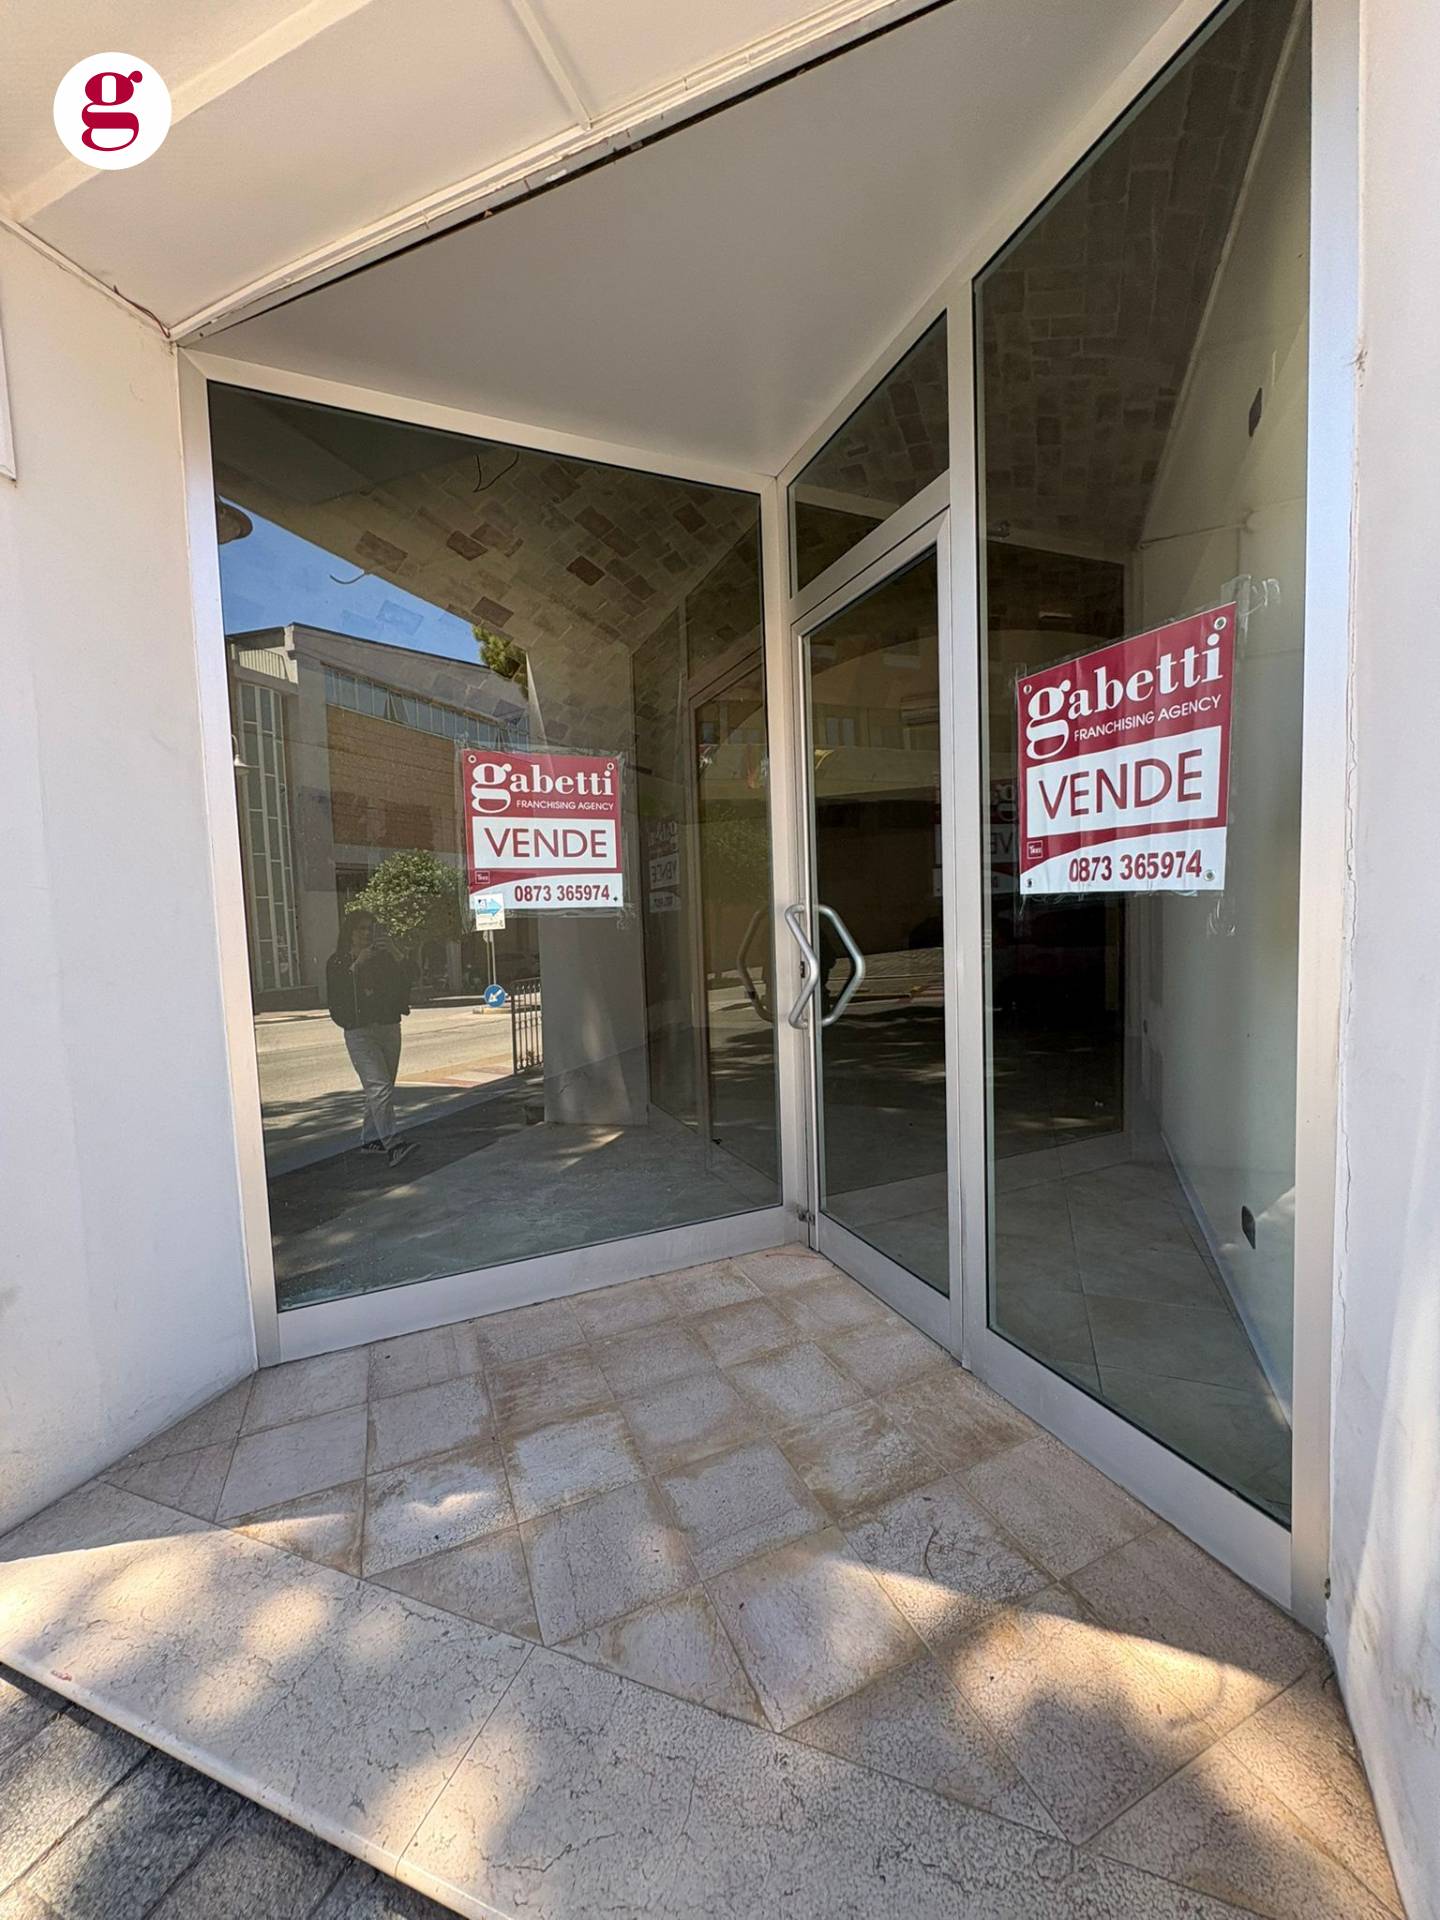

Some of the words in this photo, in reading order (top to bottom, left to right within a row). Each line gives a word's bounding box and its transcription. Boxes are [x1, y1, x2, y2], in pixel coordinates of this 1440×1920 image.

[1026, 633, 1223, 760] gabetti
[1073, 711, 1155, 742] FRANCHISING
[1157, 694, 1222, 721] AGENCY
[471, 763, 614, 814] gabetti
[1038, 749, 1202, 819] VENDE
[516, 799, 576, 810] FRANCHISING
[577, 802, 614, 811] AGENCY
[484, 827, 606, 858] VENDE
[1069, 857, 1112, 882] 0873
[1119, 849, 1202, 880] 365974
[514, 885, 551, 902] 0873
[555, 884, 610, 901] 365974
